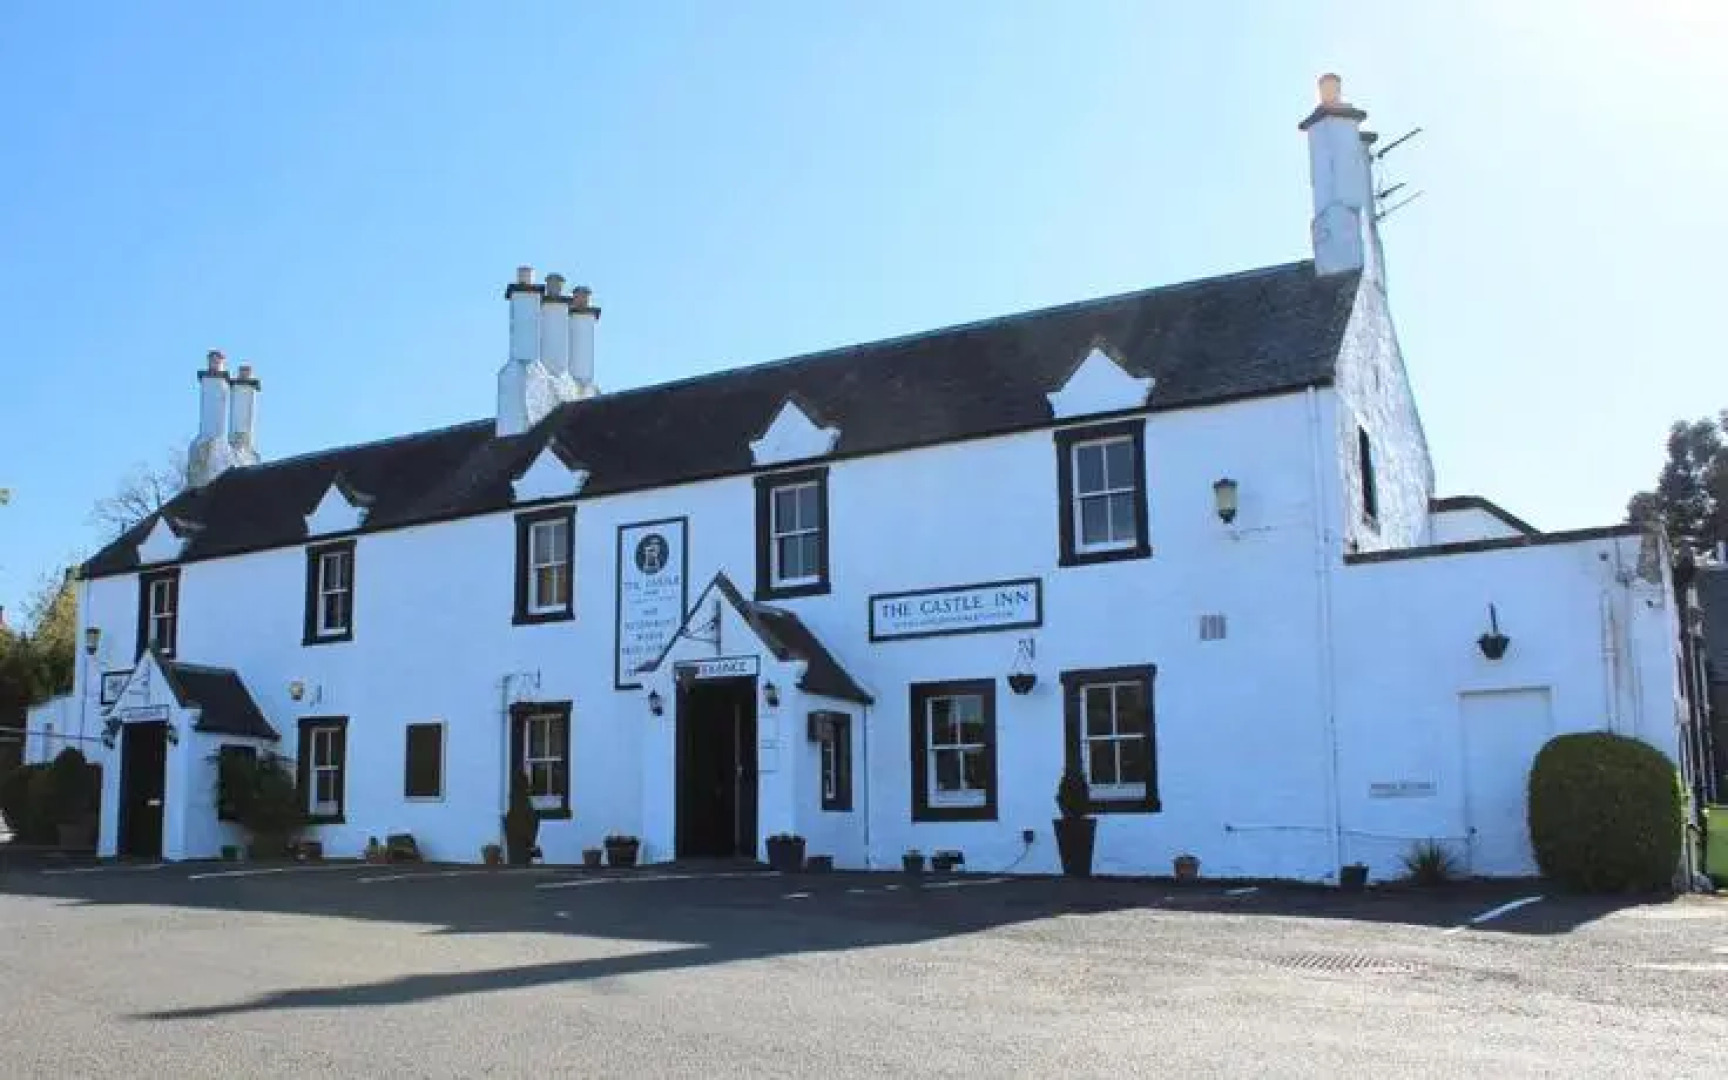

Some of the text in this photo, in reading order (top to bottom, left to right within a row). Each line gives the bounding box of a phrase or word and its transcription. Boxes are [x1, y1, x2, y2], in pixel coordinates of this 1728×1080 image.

[882, 590, 1029, 618] THE CASTLE INN
